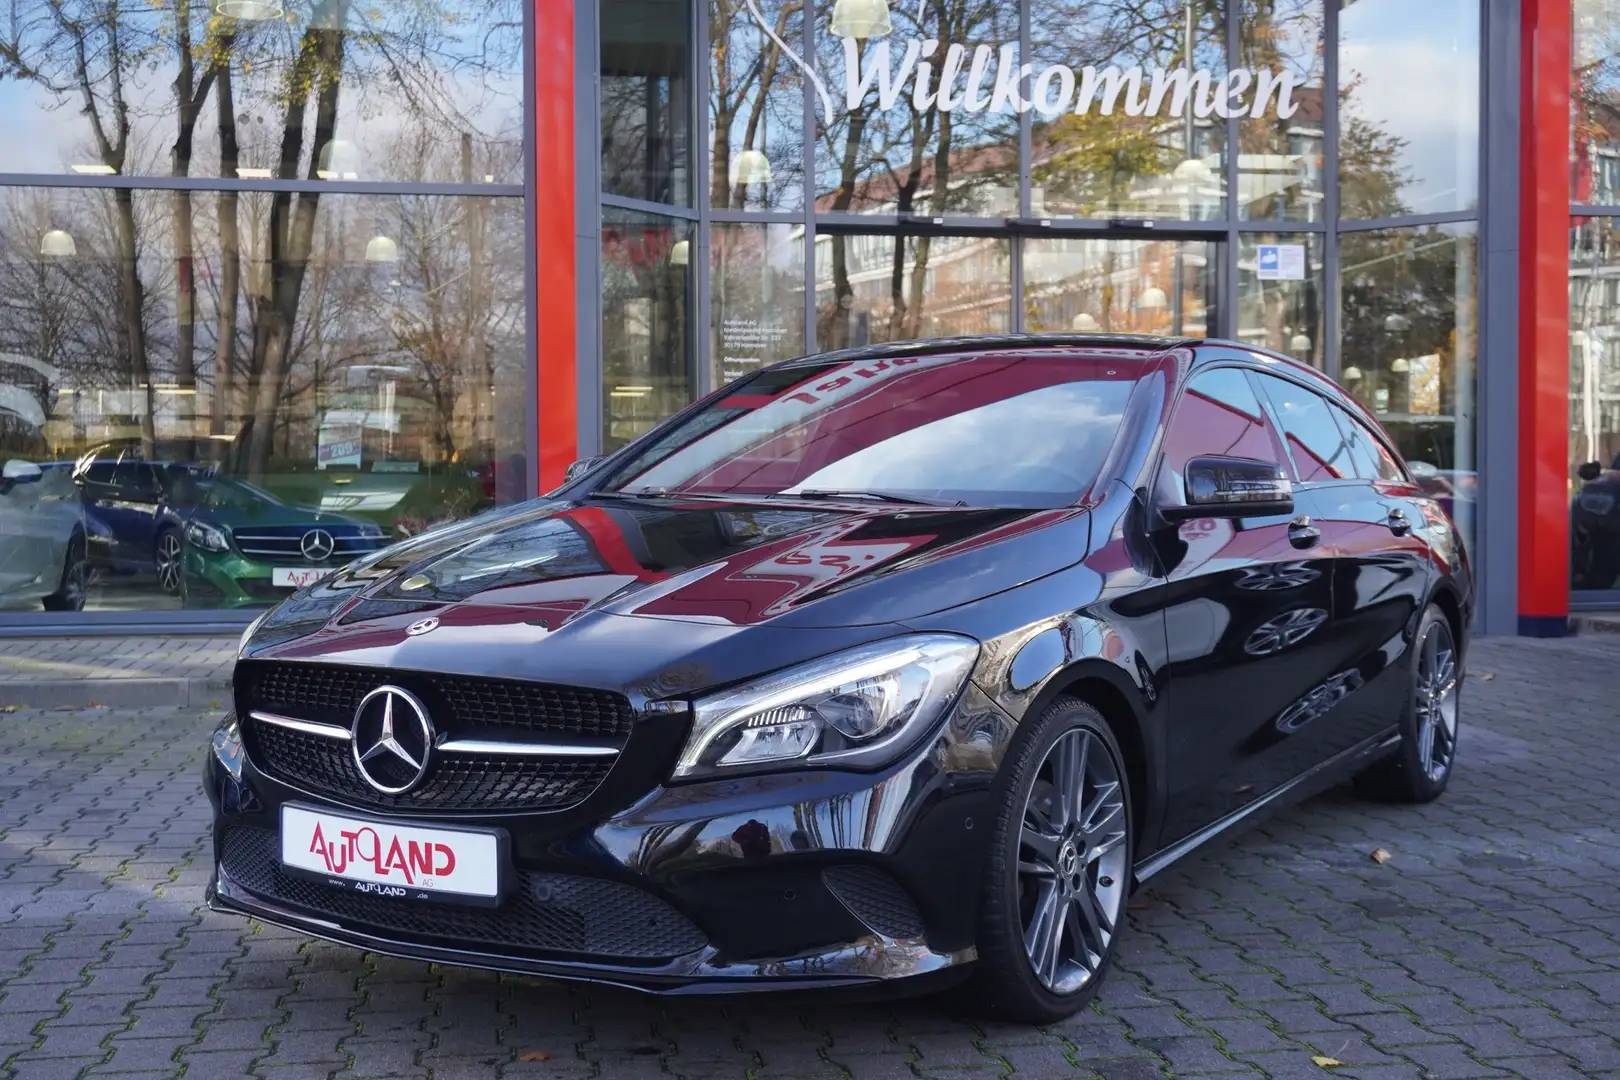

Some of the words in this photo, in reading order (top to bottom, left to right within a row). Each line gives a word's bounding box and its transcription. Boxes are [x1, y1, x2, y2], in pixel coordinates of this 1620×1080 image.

[841, 36, 1299, 120] Willkommen
[309, 820, 456, 885] AUTOLAND
[328, 878, 346, 887] www.
[355, 881, 407, 897] AUTOLAND
[422, 878, 434, 888] AG
